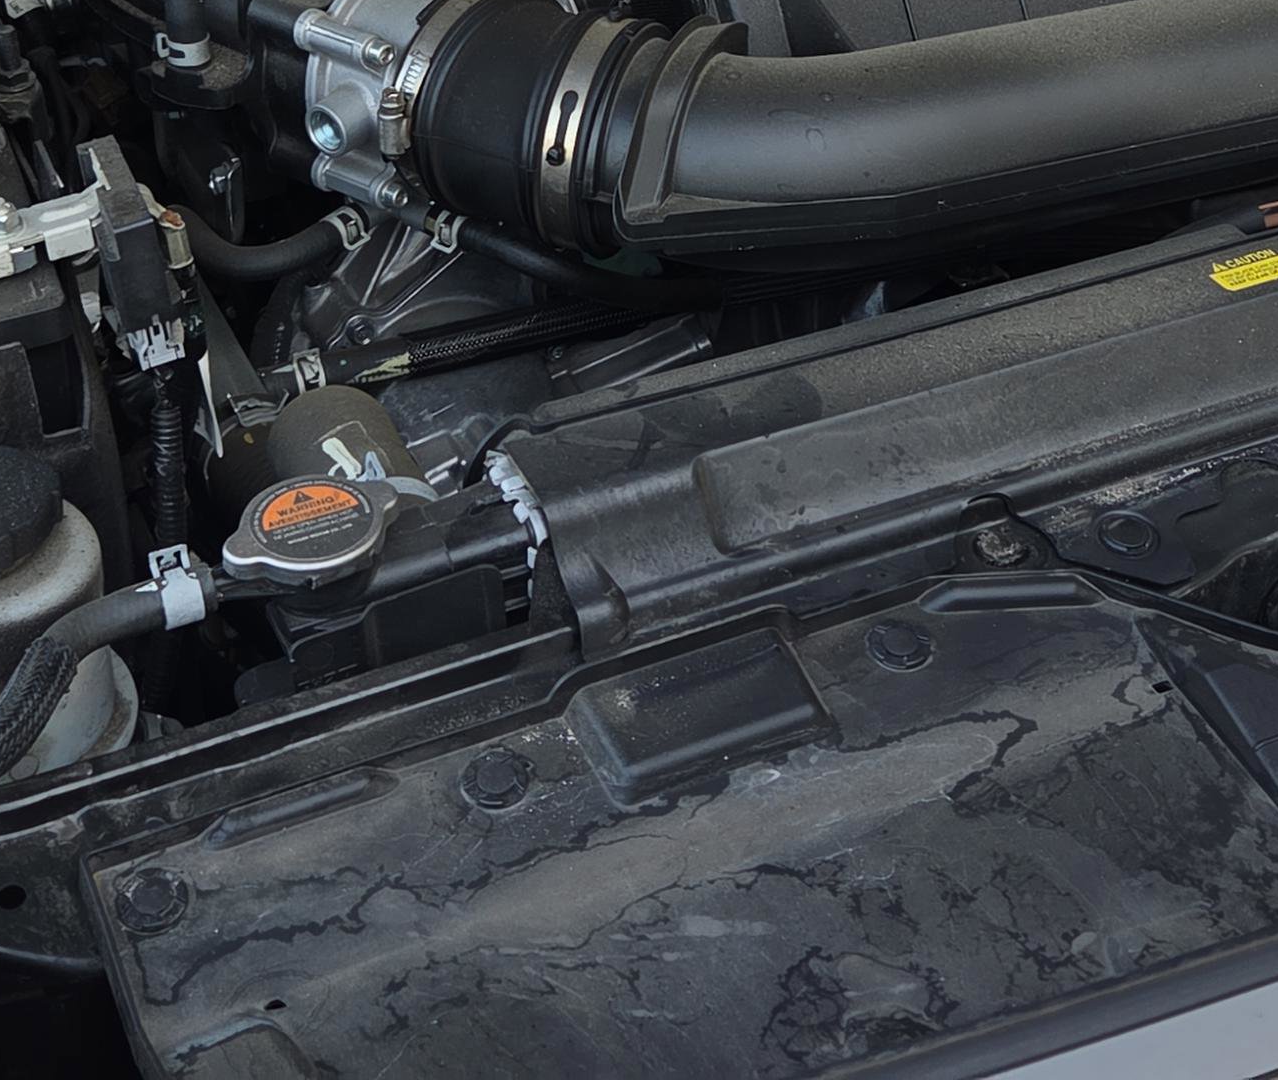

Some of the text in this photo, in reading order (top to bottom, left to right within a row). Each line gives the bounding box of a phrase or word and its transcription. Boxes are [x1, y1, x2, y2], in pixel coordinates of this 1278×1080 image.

[1225, 249, 1277, 269] CAUTION
[268, 499, 352, 528] AVERTISSEMENT
[276, 496, 334, 516] WARNING
